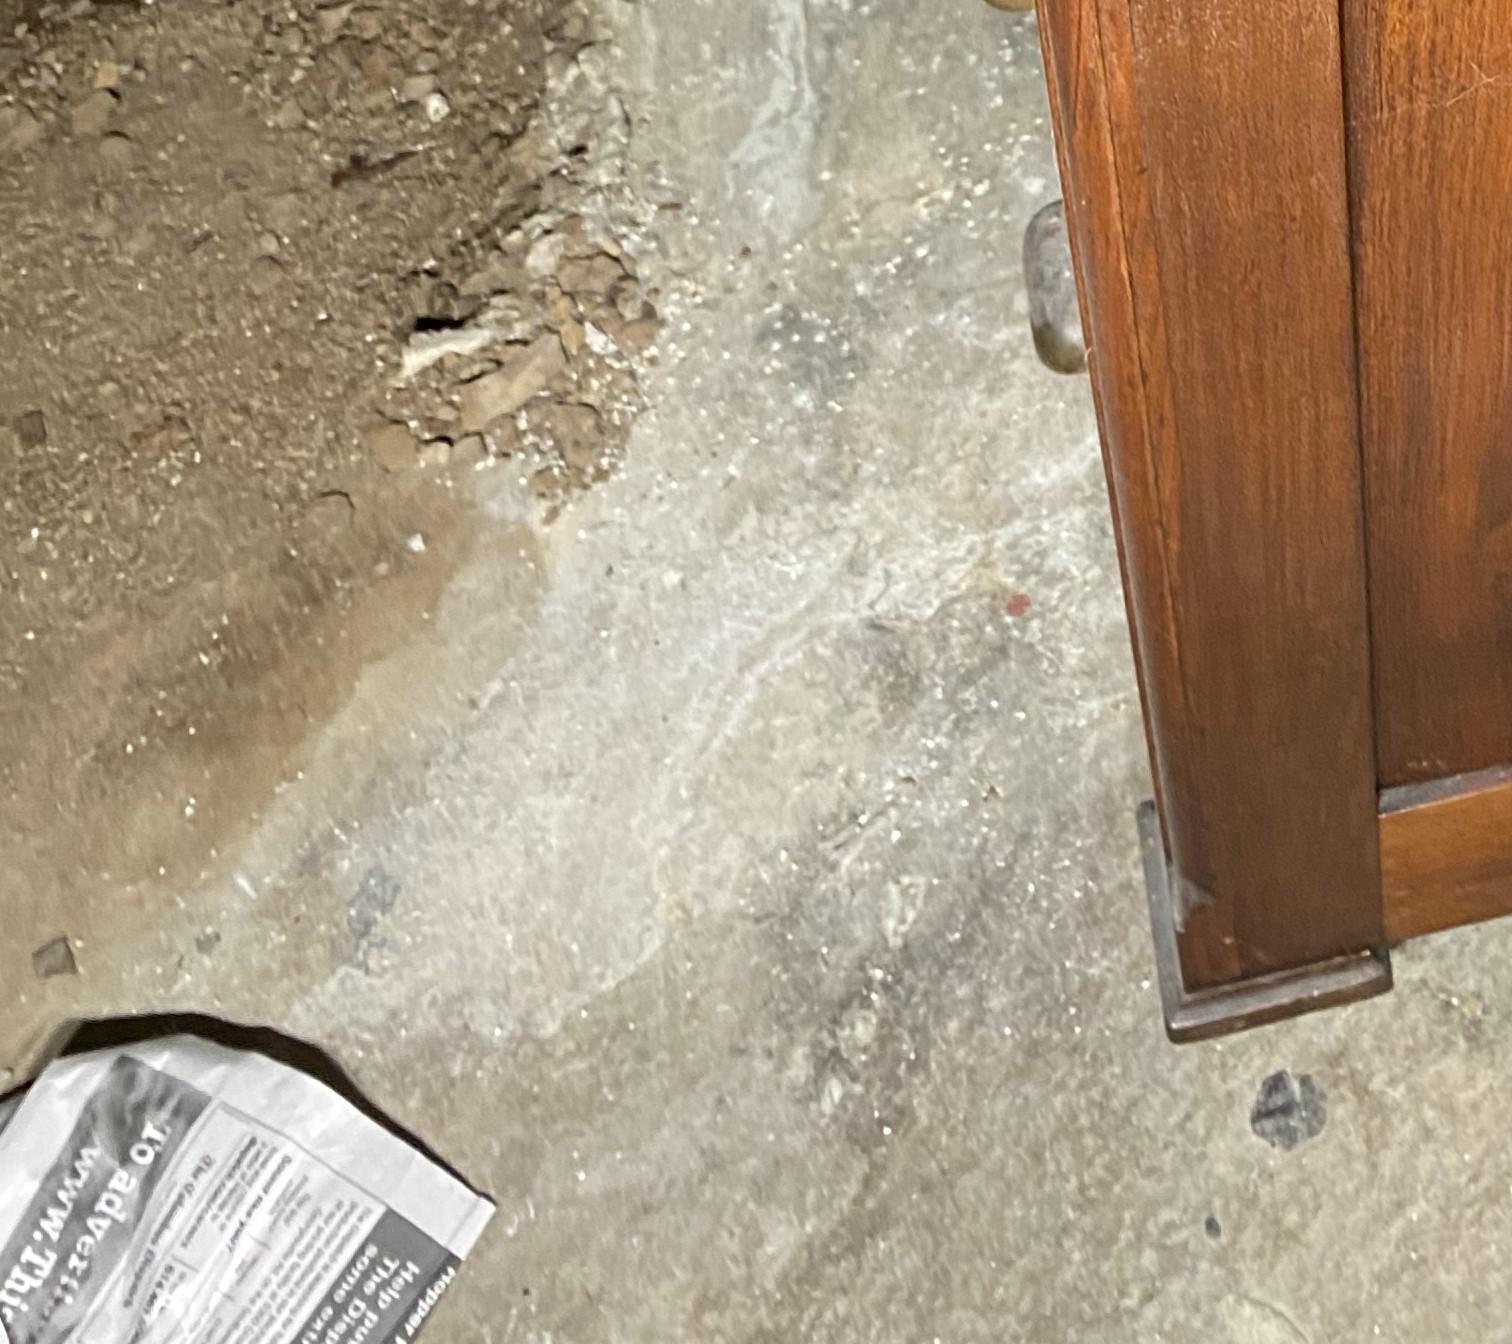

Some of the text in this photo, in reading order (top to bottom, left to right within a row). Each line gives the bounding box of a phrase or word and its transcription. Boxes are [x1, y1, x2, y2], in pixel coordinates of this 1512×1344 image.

[130, 1121, 171, 1165] To
[333, 1243, 378, 1304] some
[363, 1256, 400, 1296] The
[377, 1260, 420, 1310] Help
